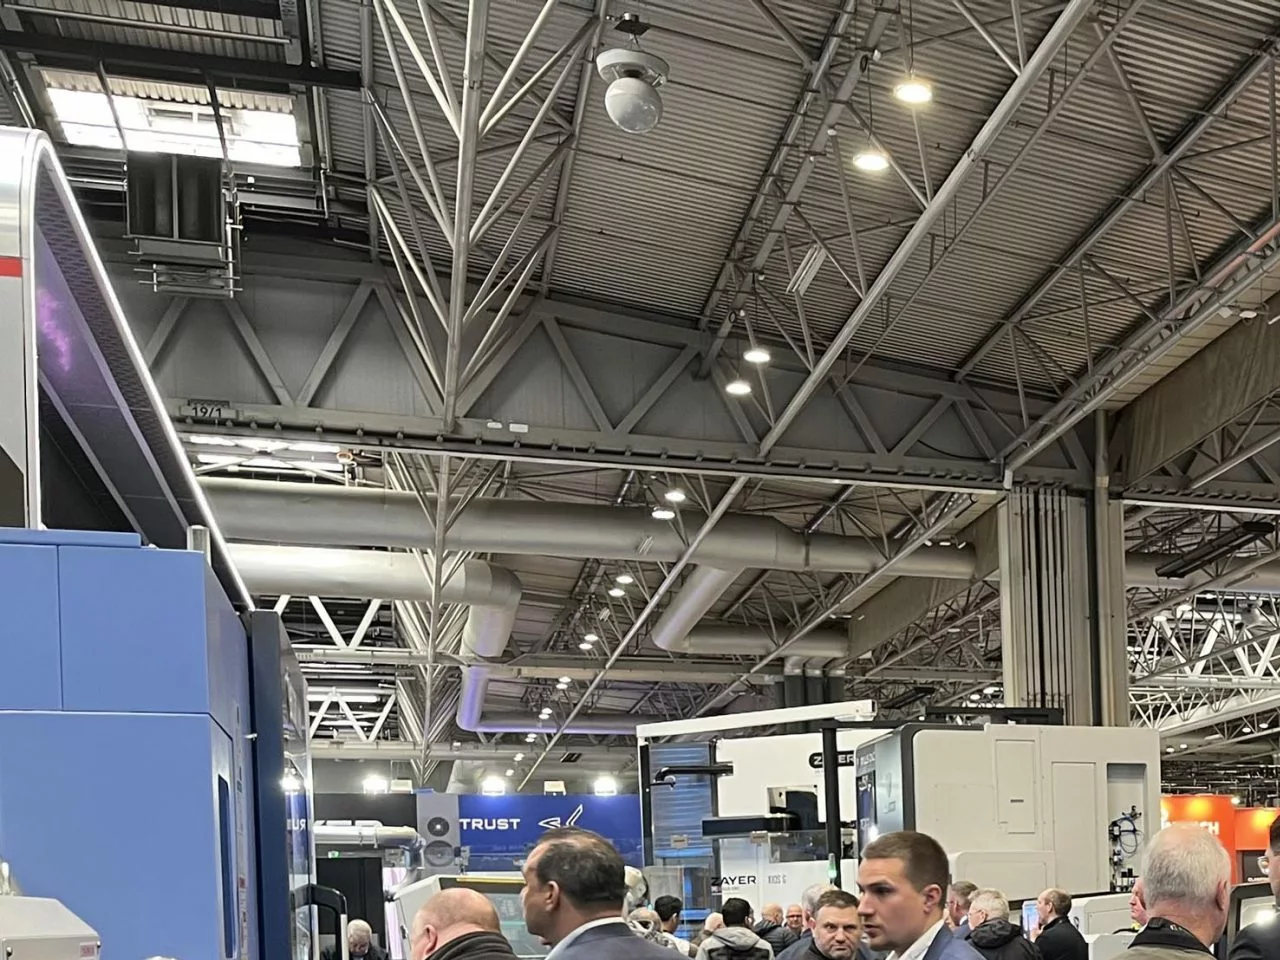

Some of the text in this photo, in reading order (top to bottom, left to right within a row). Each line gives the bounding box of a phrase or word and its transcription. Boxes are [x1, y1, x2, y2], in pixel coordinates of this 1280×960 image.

[191, 406, 222, 418] 19/1
[814, 754, 855, 765] ZER
[459, 818, 521, 830] TRUST
[711, 875, 757, 886] ZAYER
